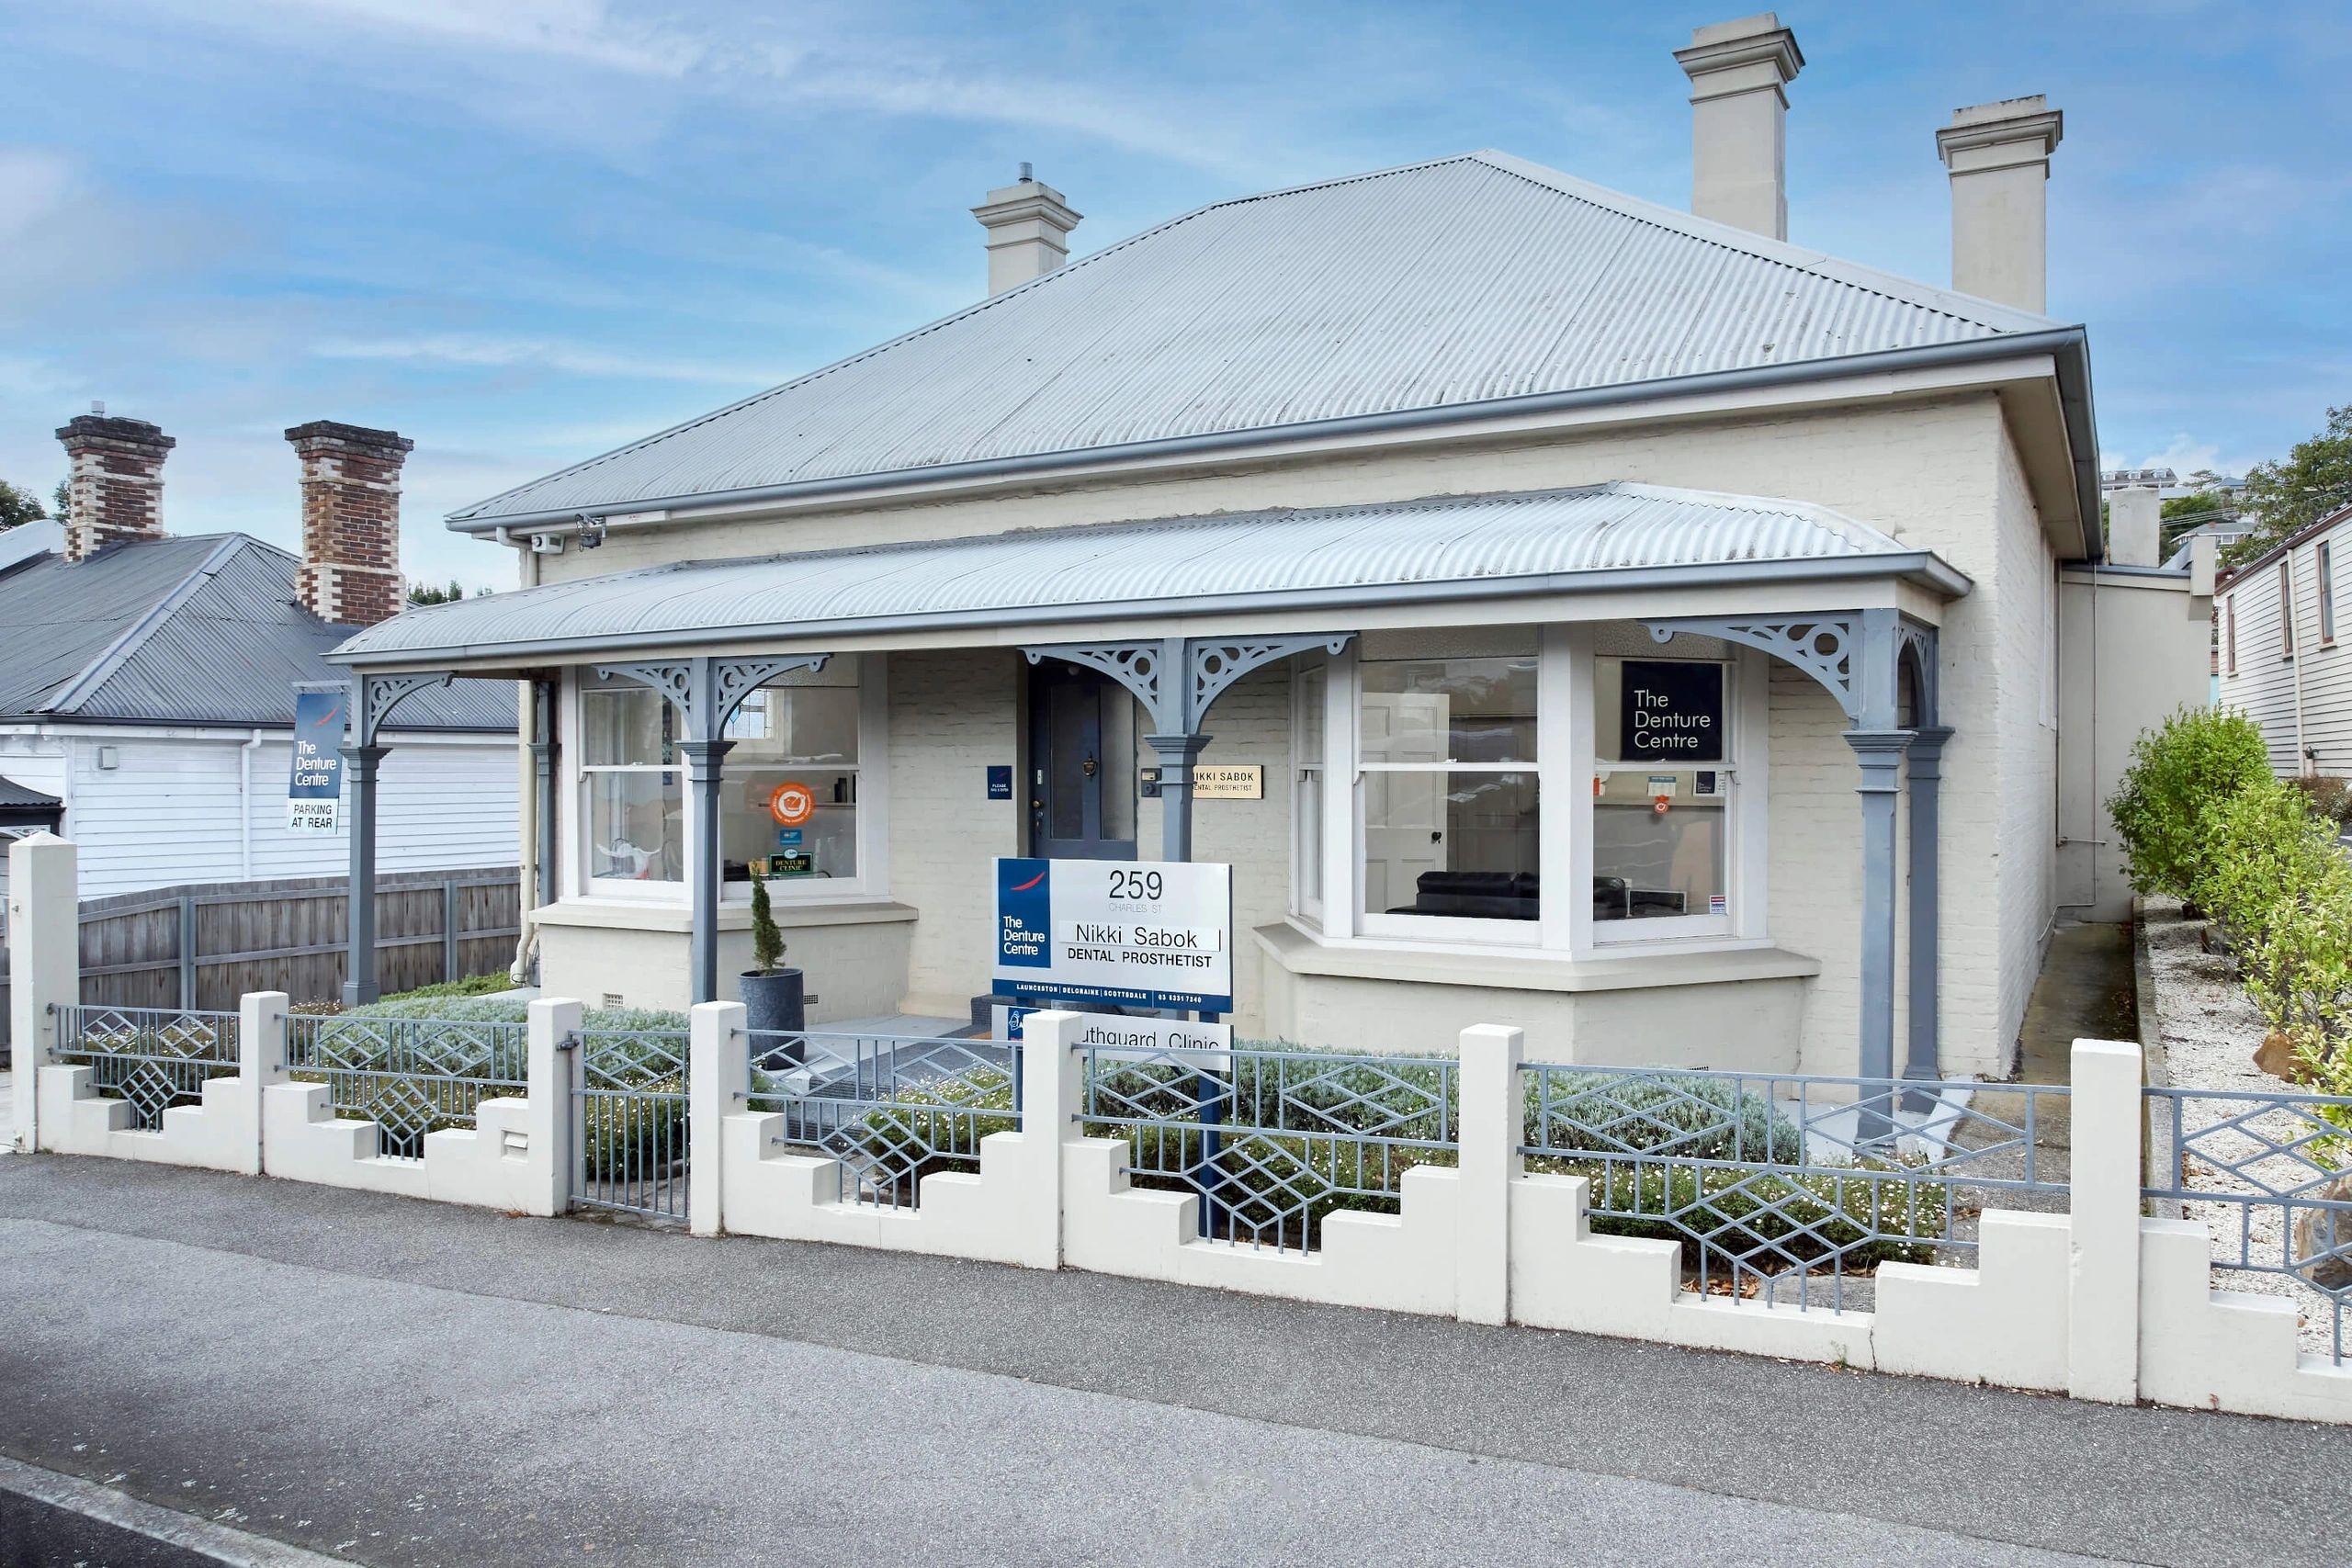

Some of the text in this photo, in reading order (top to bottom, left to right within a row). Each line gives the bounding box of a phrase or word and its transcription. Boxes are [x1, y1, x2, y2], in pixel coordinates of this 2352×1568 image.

[1634, 690, 1668, 707] The
[1634, 711, 1711, 728] Denture
[1634, 731, 1699, 749] Centre
[297, 740, 316, 754] The
[297, 757, 336, 770] Denture
[295, 773, 329, 786] Centre
[1195, 773, 1254, 781] IKKI SABOK
[294, 804, 332, 815] PARKING
[291, 818, 332, 828] AT REAR
[1109, 870, 1163, 900] 259
[1109, 903, 1161, 913] CHARLES ST
[1003, 916, 1023, 929] The
[1004, 929, 1046, 942] Denture
[1076, 924, 1197, 948] Nikki Sabok
[1003, 942, 1038, 955] Centre
[1068, 948, 1212, 967] DENTAL PROSTHETIST
[1016, 984, 1058, 993] LAUNCESTON
[1103, 989, 1147, 999] SCOTTSDALE
[1169, 1032, 1219, 1051] Clinic
